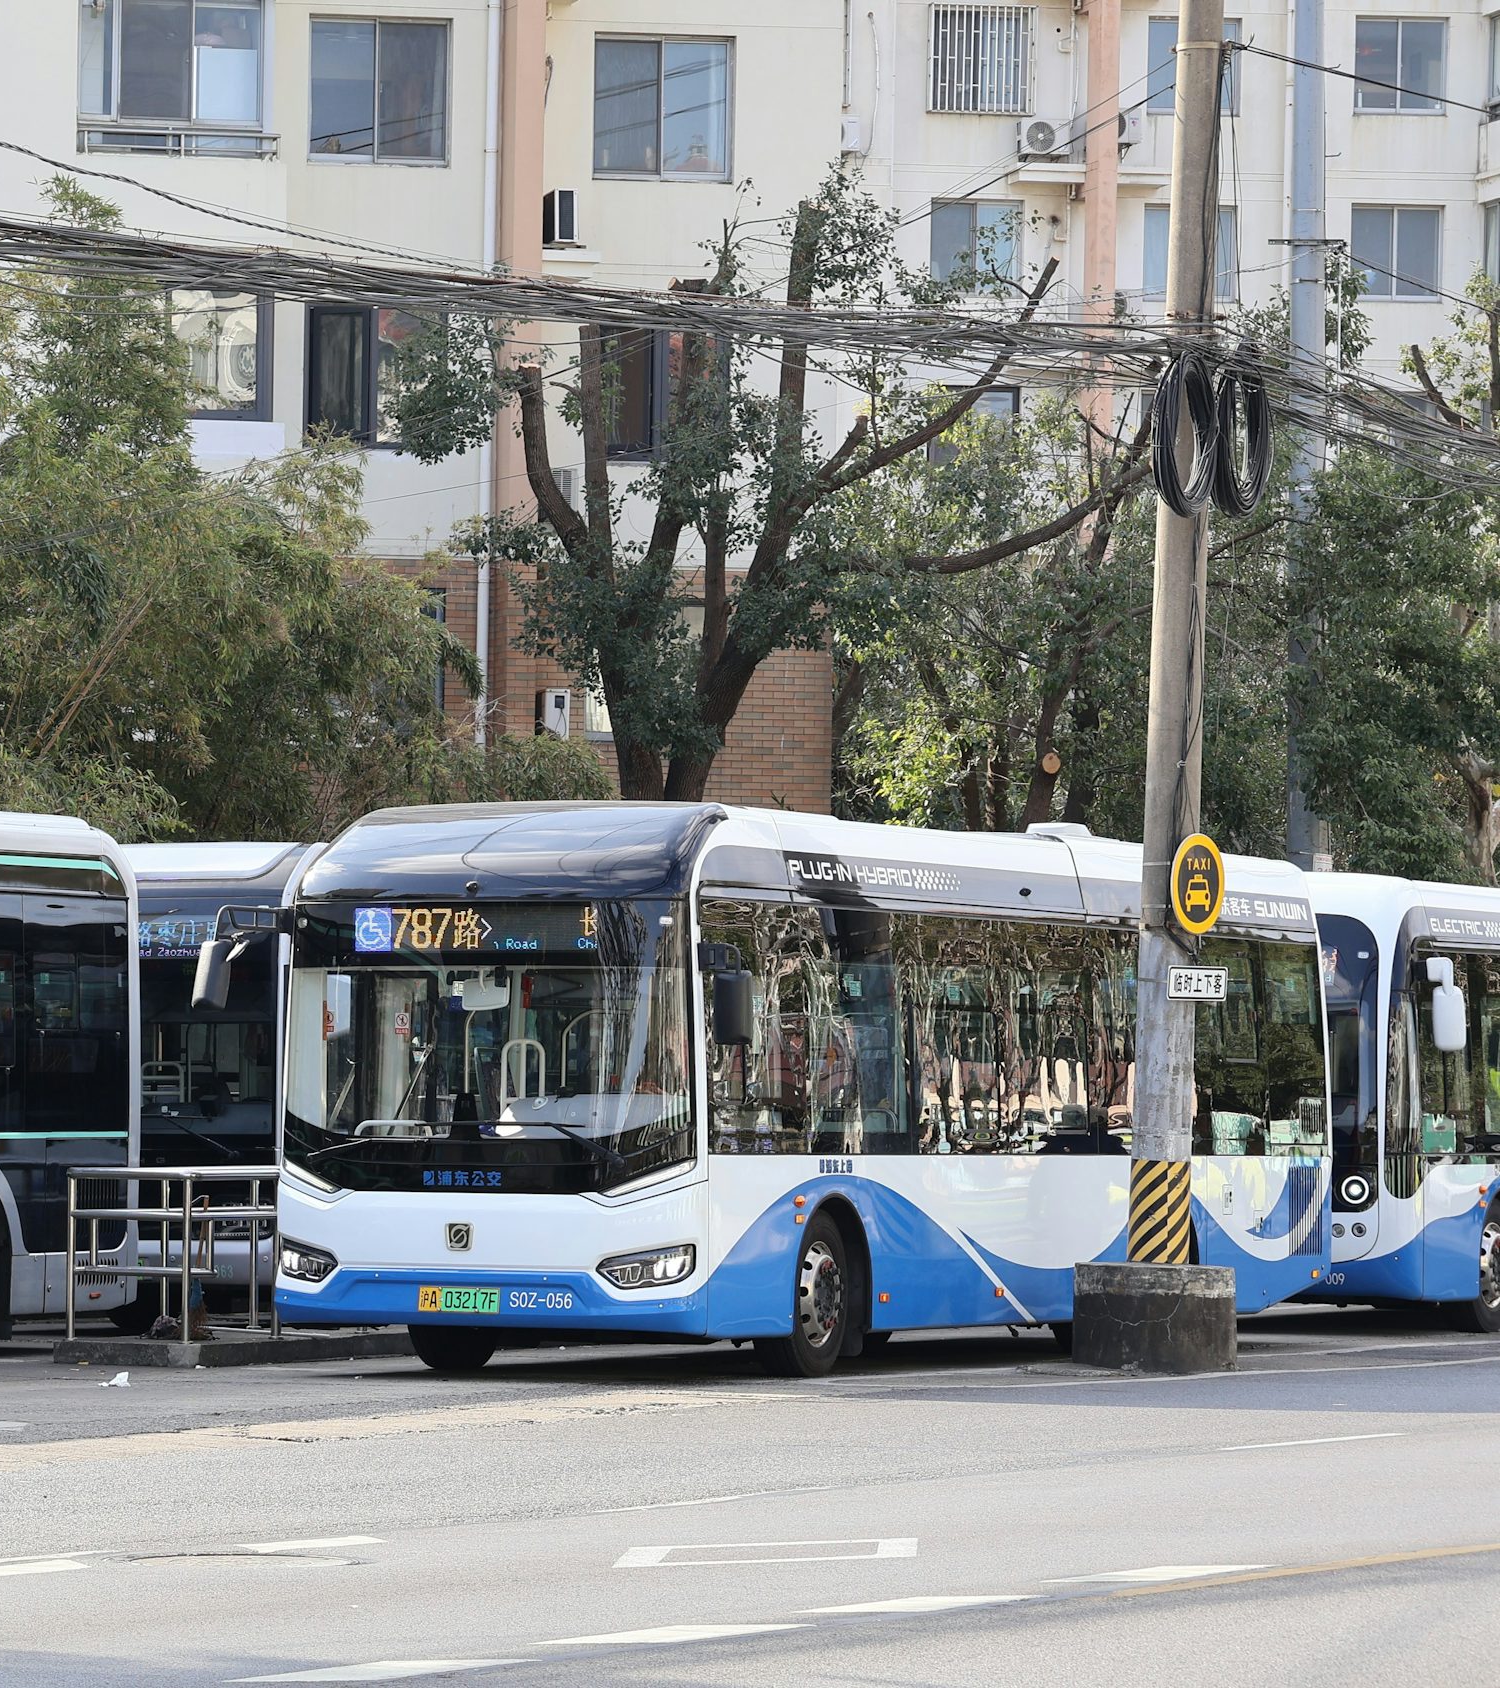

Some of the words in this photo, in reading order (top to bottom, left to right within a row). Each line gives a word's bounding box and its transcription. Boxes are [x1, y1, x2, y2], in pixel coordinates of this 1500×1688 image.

[788, 859, 853, 882] PLUG-IN
[855, 865, 913, 886] HYBRID
[1187, 858, 1211, 870] TAXI
[1254, 900, 1308, 921] SUNWIN
[392, 907, 482, 949] 787路
[1430, 917, 1484, 936] ELECTRIC
[506, 939, 538, 949] Road
[1174, 973, 1223, 994] 临时上下客
[438, 1170, 502, 1186] 浦东公交
